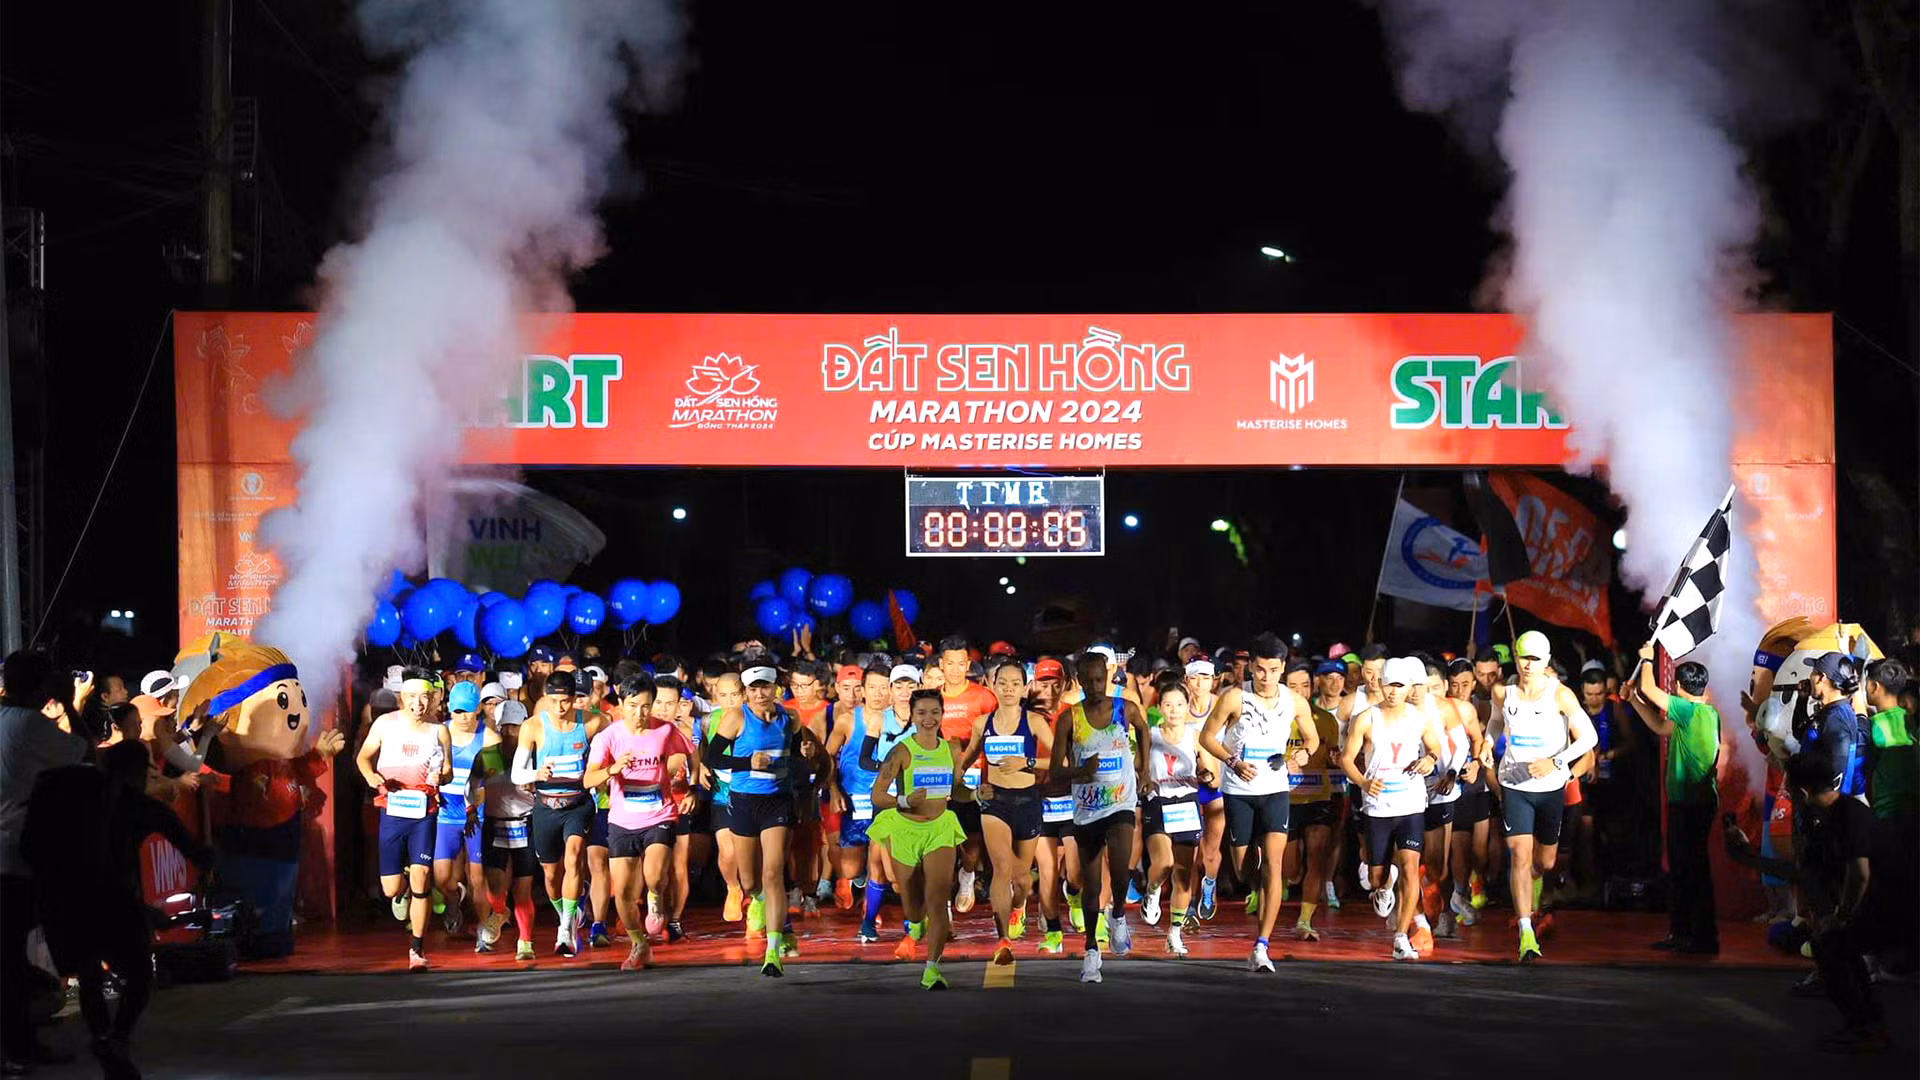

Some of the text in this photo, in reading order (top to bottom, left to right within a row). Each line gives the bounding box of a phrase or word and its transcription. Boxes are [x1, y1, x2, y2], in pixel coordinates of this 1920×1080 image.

[822, 326, 1191, 392] ĐẤT SEN HỒNG
[672, 409, 778, 421] MARATHON
[716, 398, 740, 408] SEN
[869, 400, 1142, 424] MARATHON 2024
[1236, 419, 1348, 429] MASTERISE HOMES
[868, 430, 1142, 450] CÚP MASTERISE HOMES
[956, 481, 1049, 506] TIME
[467, 517, 541, 542] VINH
[924, 511, 1086, 548] 00:00:05
